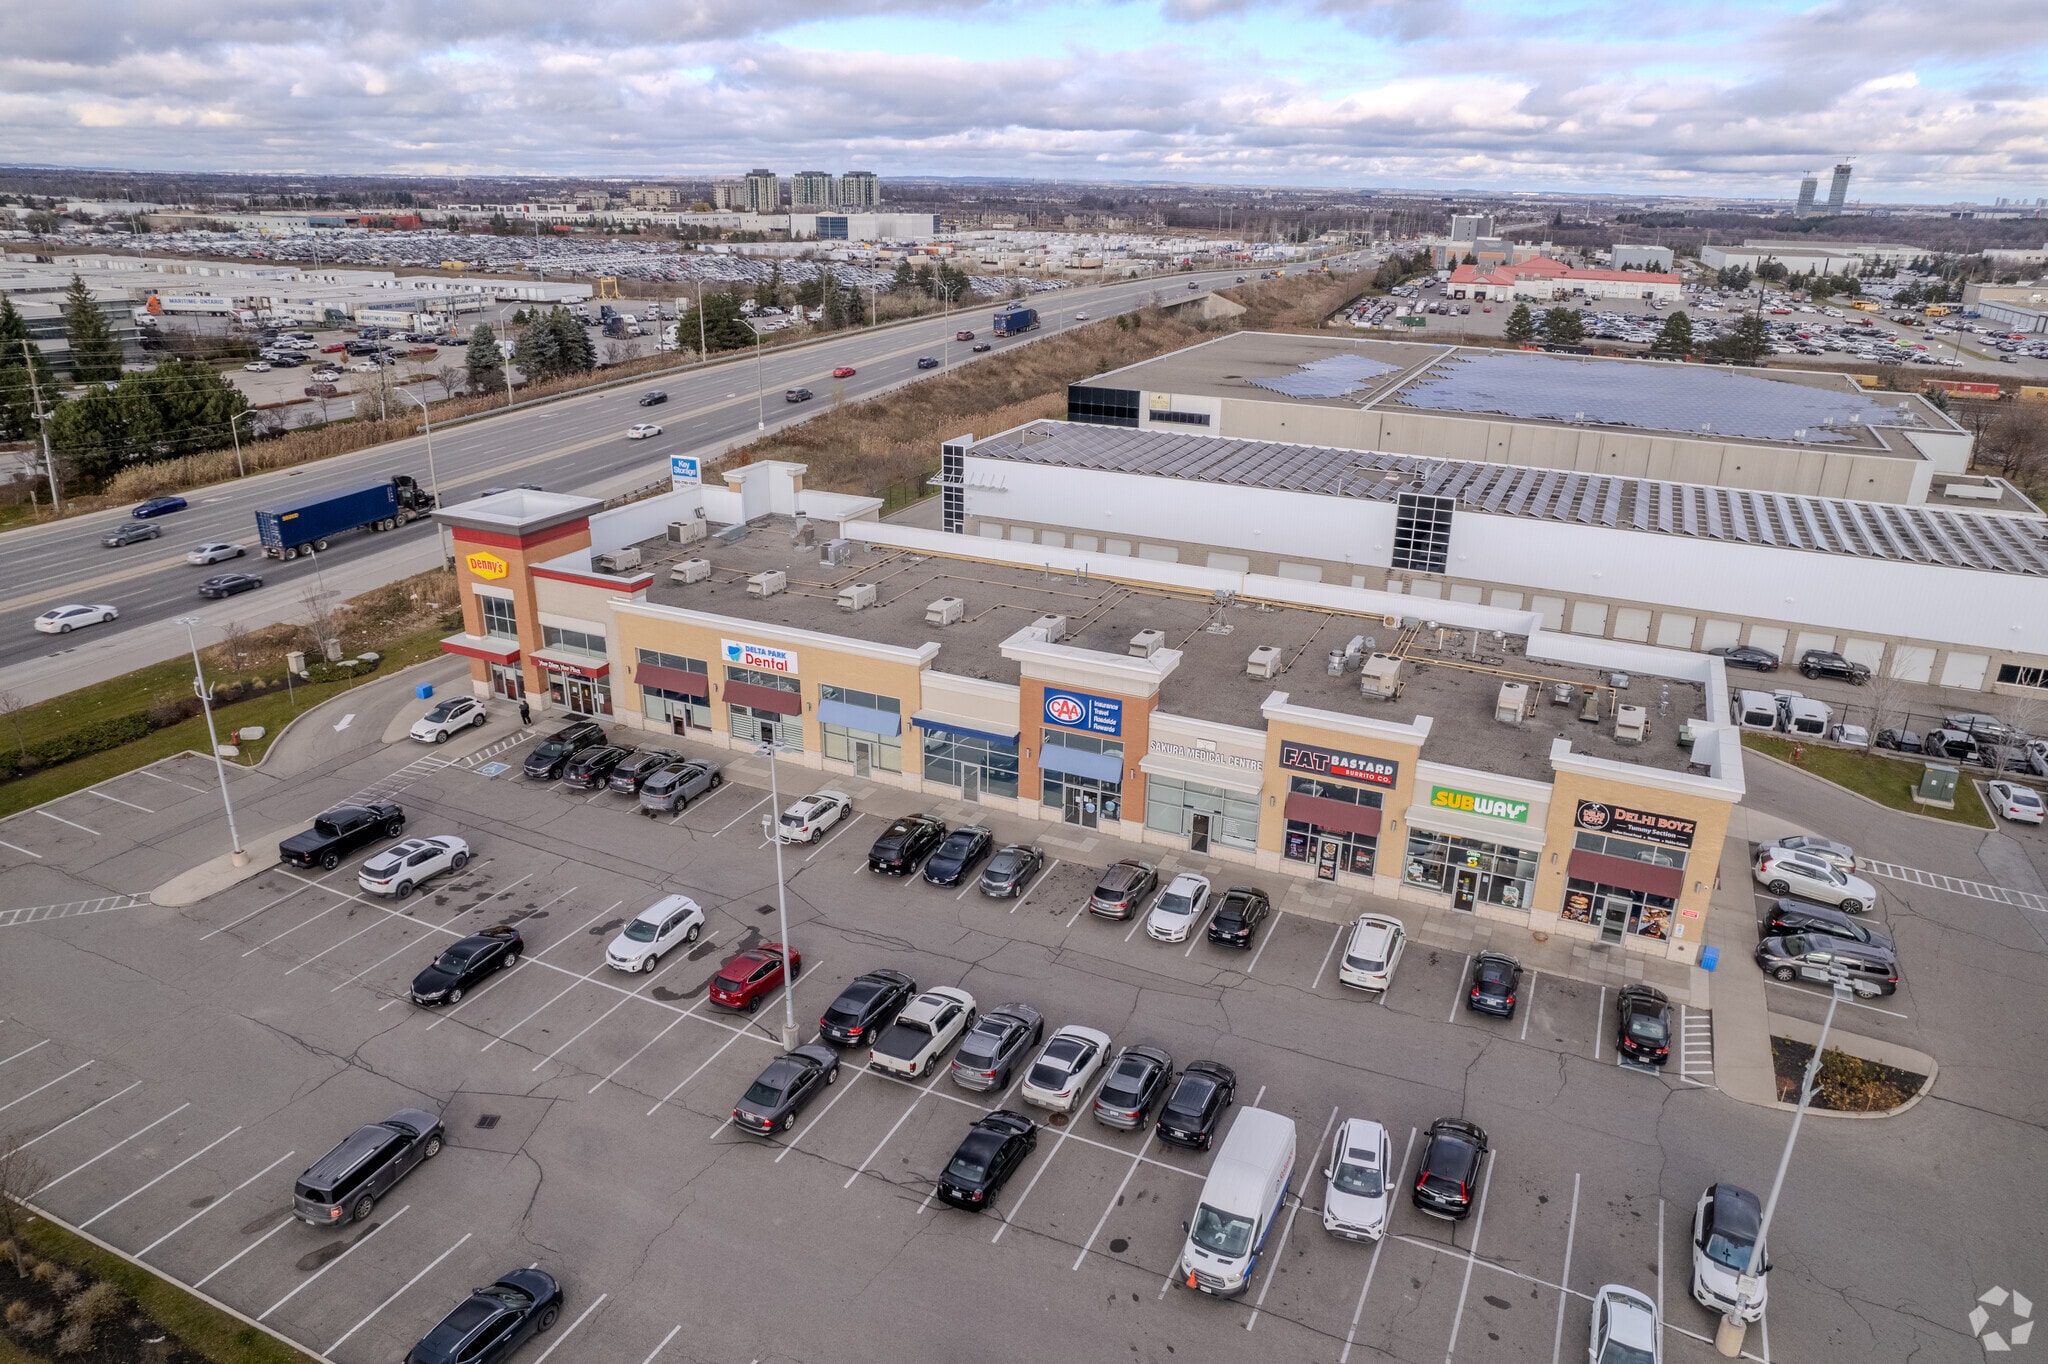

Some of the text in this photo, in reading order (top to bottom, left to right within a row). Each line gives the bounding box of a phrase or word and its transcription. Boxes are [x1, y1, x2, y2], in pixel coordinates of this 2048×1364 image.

[673, 465, 697, 477] Storage
[678, 460, 690, 470] Key
[469, 557, 503, 574] Denny's
[745, 645, 787, 659] DELTA PARK
[745, 653, 788, 671] Dental
[1051, 699, 1079, 720] CAA
[1094, 700, 1119, 711] Insurance
[1094, 708, 1110, 716] Travel
[1093, 716, 1117, 725] Roadside
[1093, 723, 1116, 733] Rewards
[1150, 740, 1263, 771] SAKURA MEDICAL CENTRE
[1283, 747, 1394, 775] FAT BASTARD
[1345, 769, 1391, 783] BURRITO CO.
[1432, 791, 1527, 819] SUBWAY
[1614, 809, 1656, 826] DELHI
[1657, 818, 1694, 833] BOYZ
[1628, 824, 1676, 839] Tummy Section
